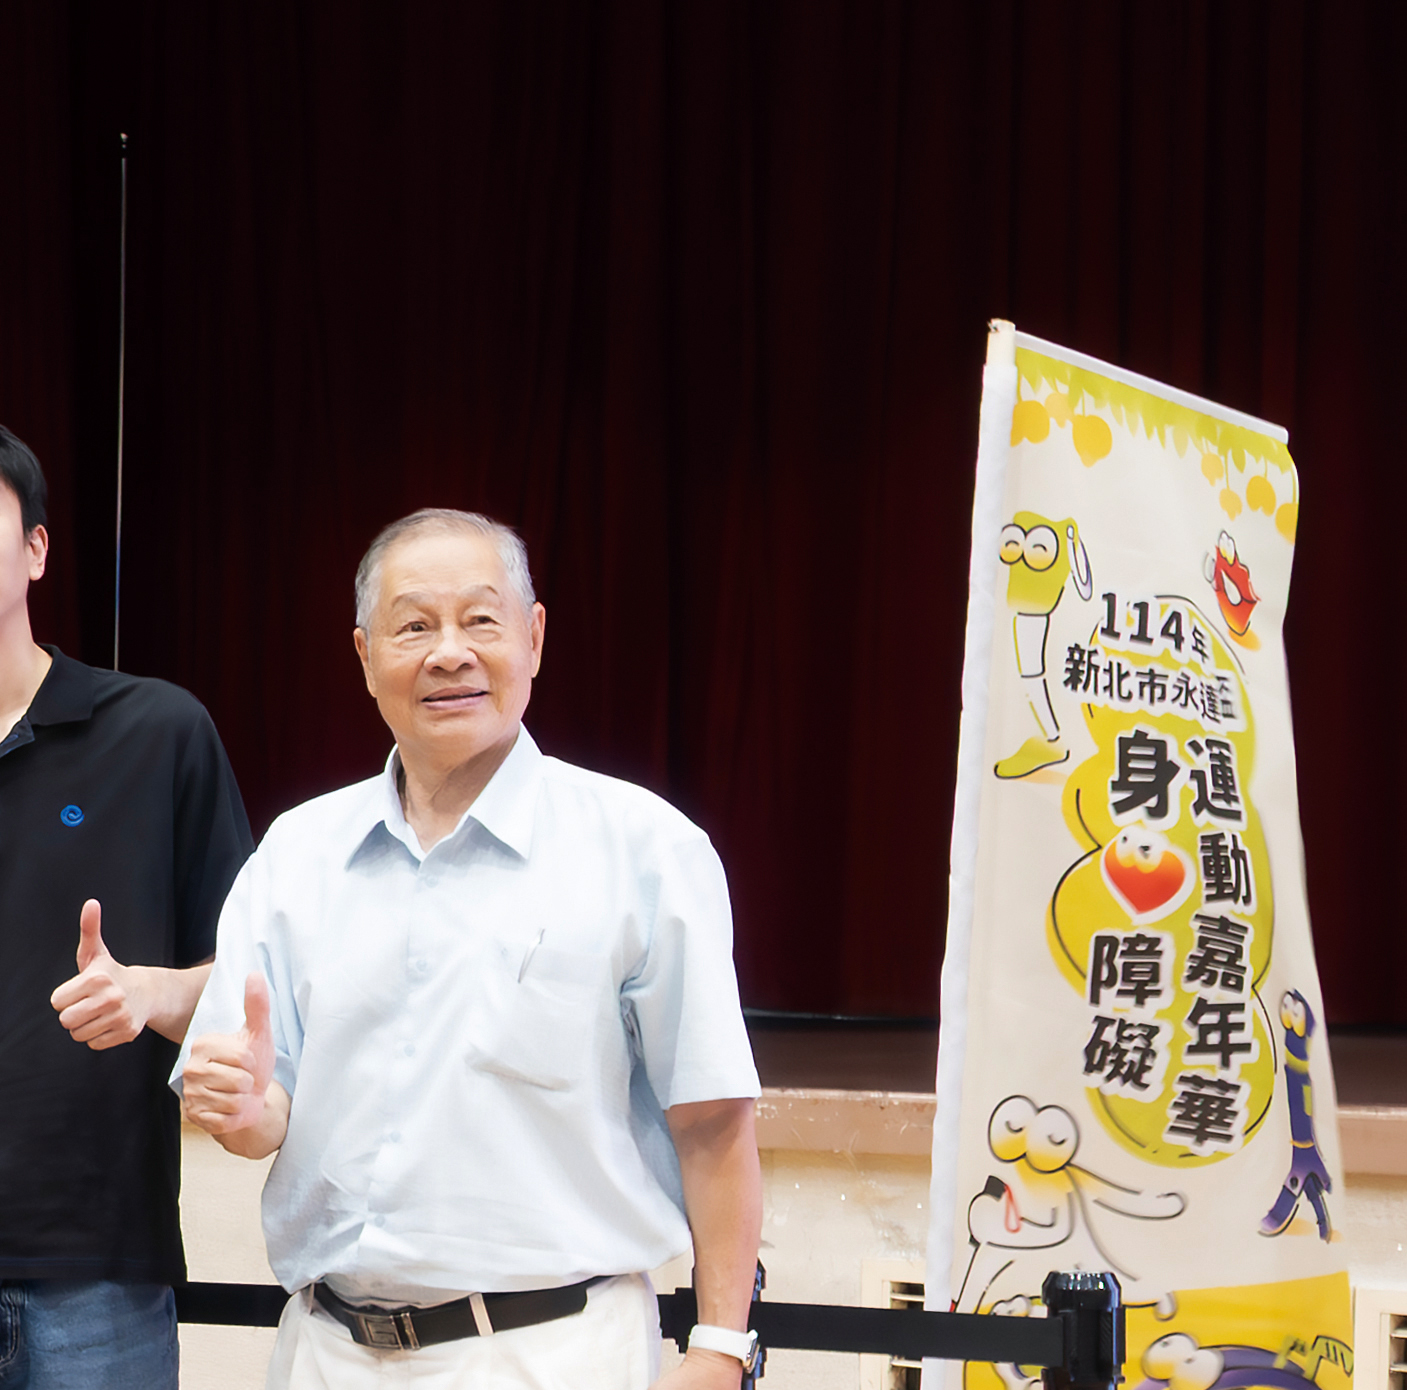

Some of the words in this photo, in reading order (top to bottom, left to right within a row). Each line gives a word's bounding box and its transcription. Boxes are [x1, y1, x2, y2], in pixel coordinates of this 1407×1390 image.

[1099, 592, 1210, 664] 114年
[1164, 737, 1253, 1147] 運動嘉年華
